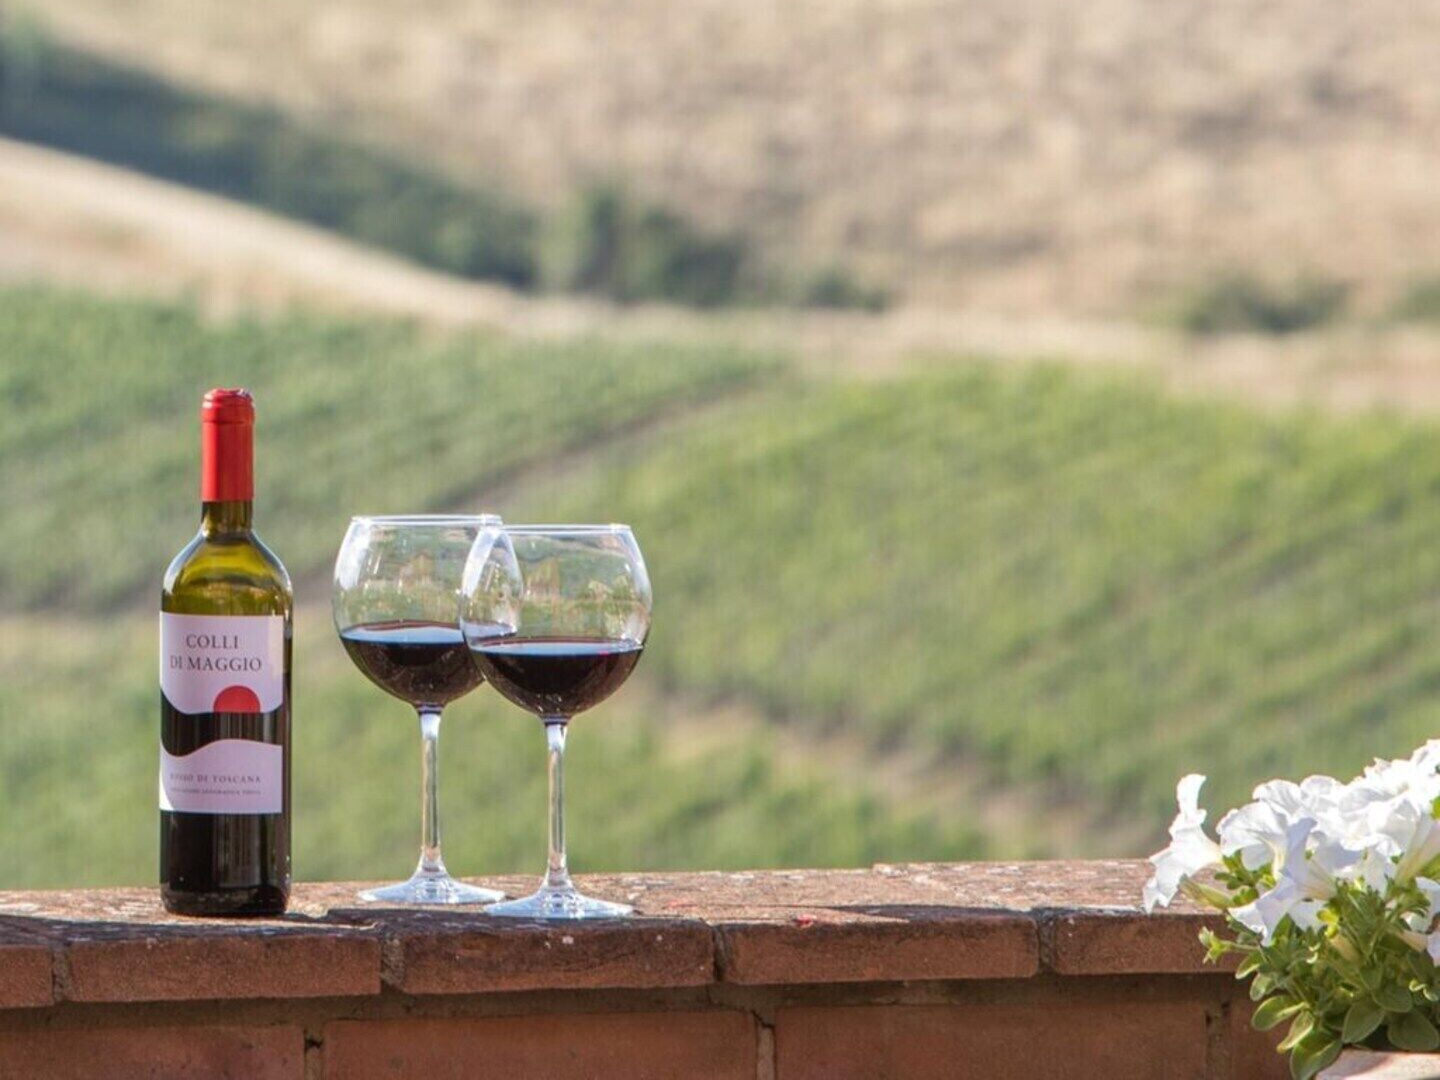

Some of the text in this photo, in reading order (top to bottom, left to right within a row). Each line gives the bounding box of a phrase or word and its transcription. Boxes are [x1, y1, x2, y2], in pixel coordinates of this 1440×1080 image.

[186, 634, 239, 649] COLLI
[170, 655, 262, 672] DI MAGGIO
[212, 775, 262, 784] TOSCANA
